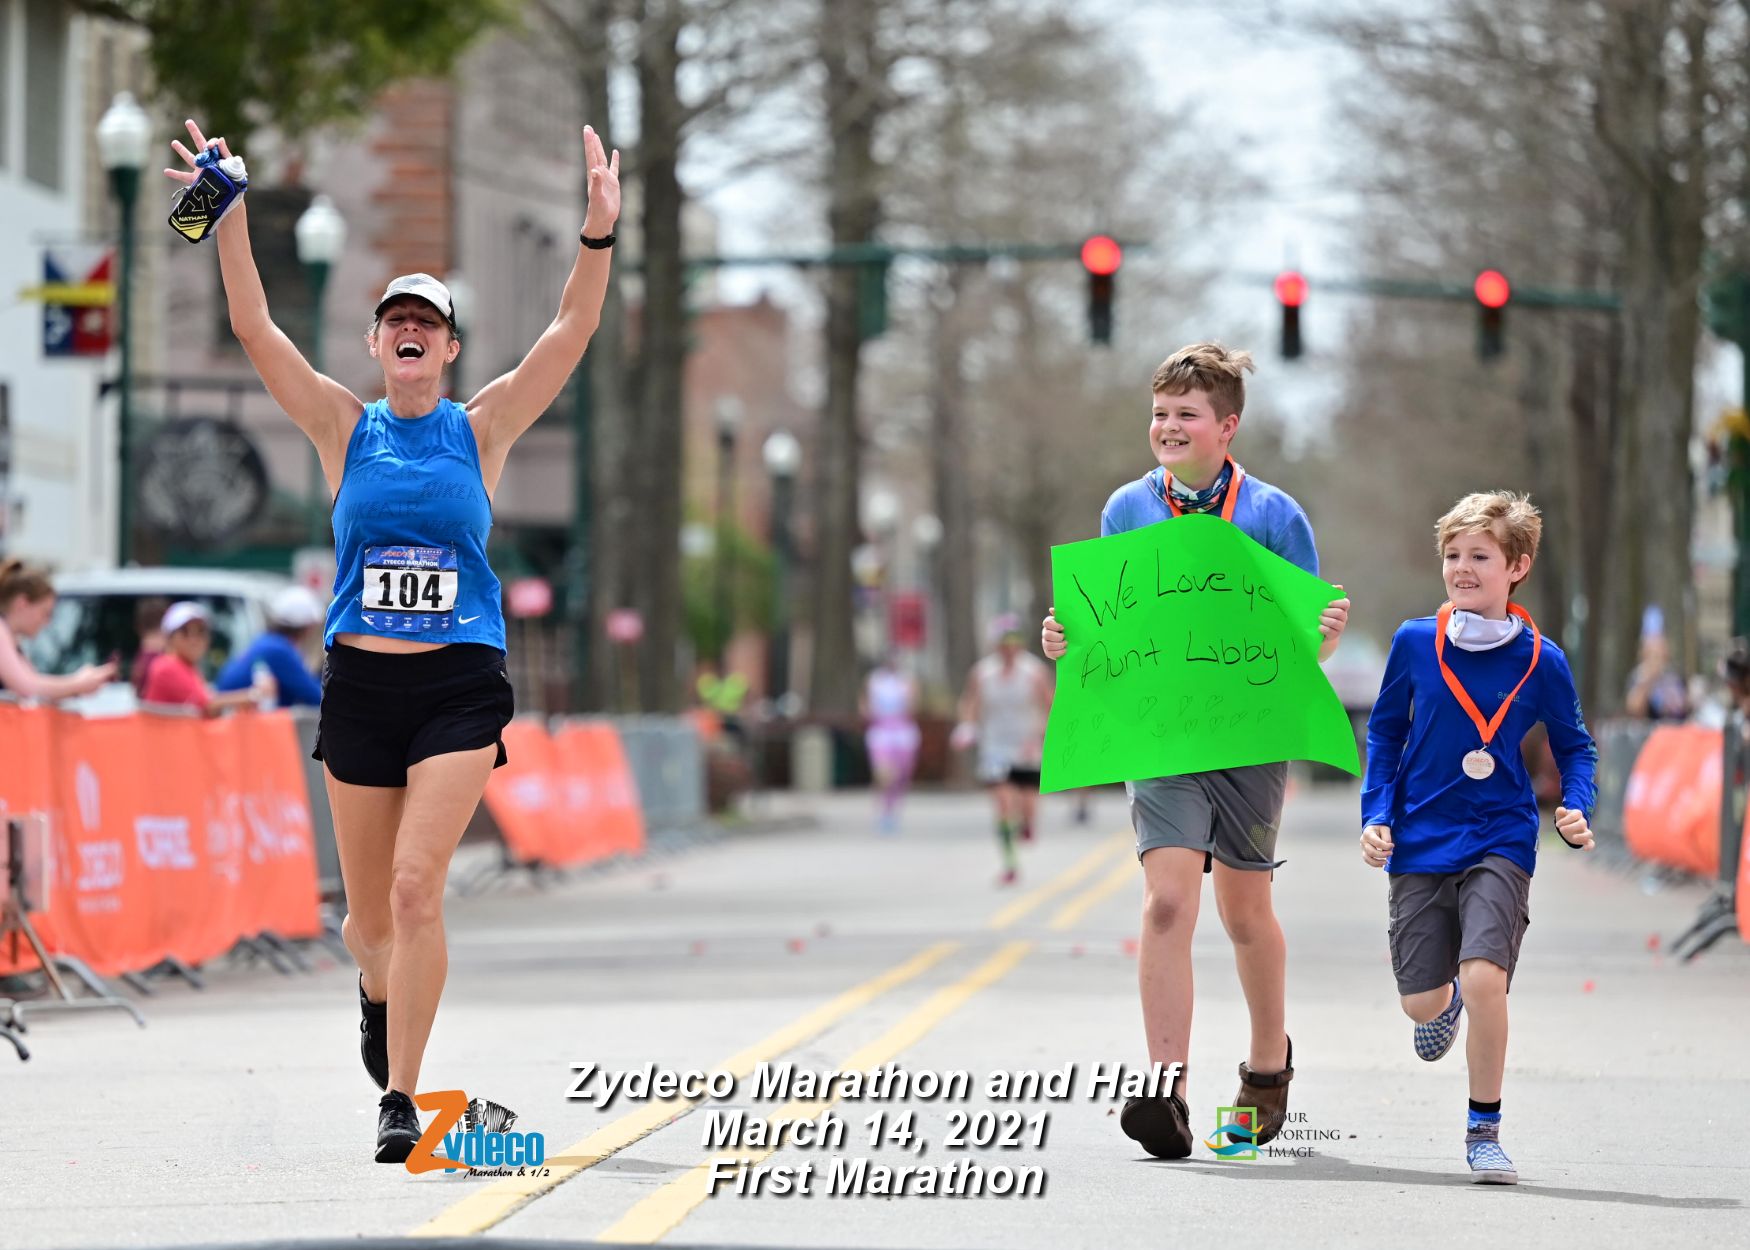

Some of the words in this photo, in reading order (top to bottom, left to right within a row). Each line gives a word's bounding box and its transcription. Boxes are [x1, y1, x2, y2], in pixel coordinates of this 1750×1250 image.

[178, 214, 208, 222] NATHAN
[406, 559, 439, 567] MARATHON
[378, 572, 443, 608] 104
[1072, 560, 1137, 627] We
[1157, 548, 1233, 598] Love
[1243, 574, 1276, 612] yo
[1081, 639, 1161, 689] Aunt
[1186, 631, 1279, 686] Libby
